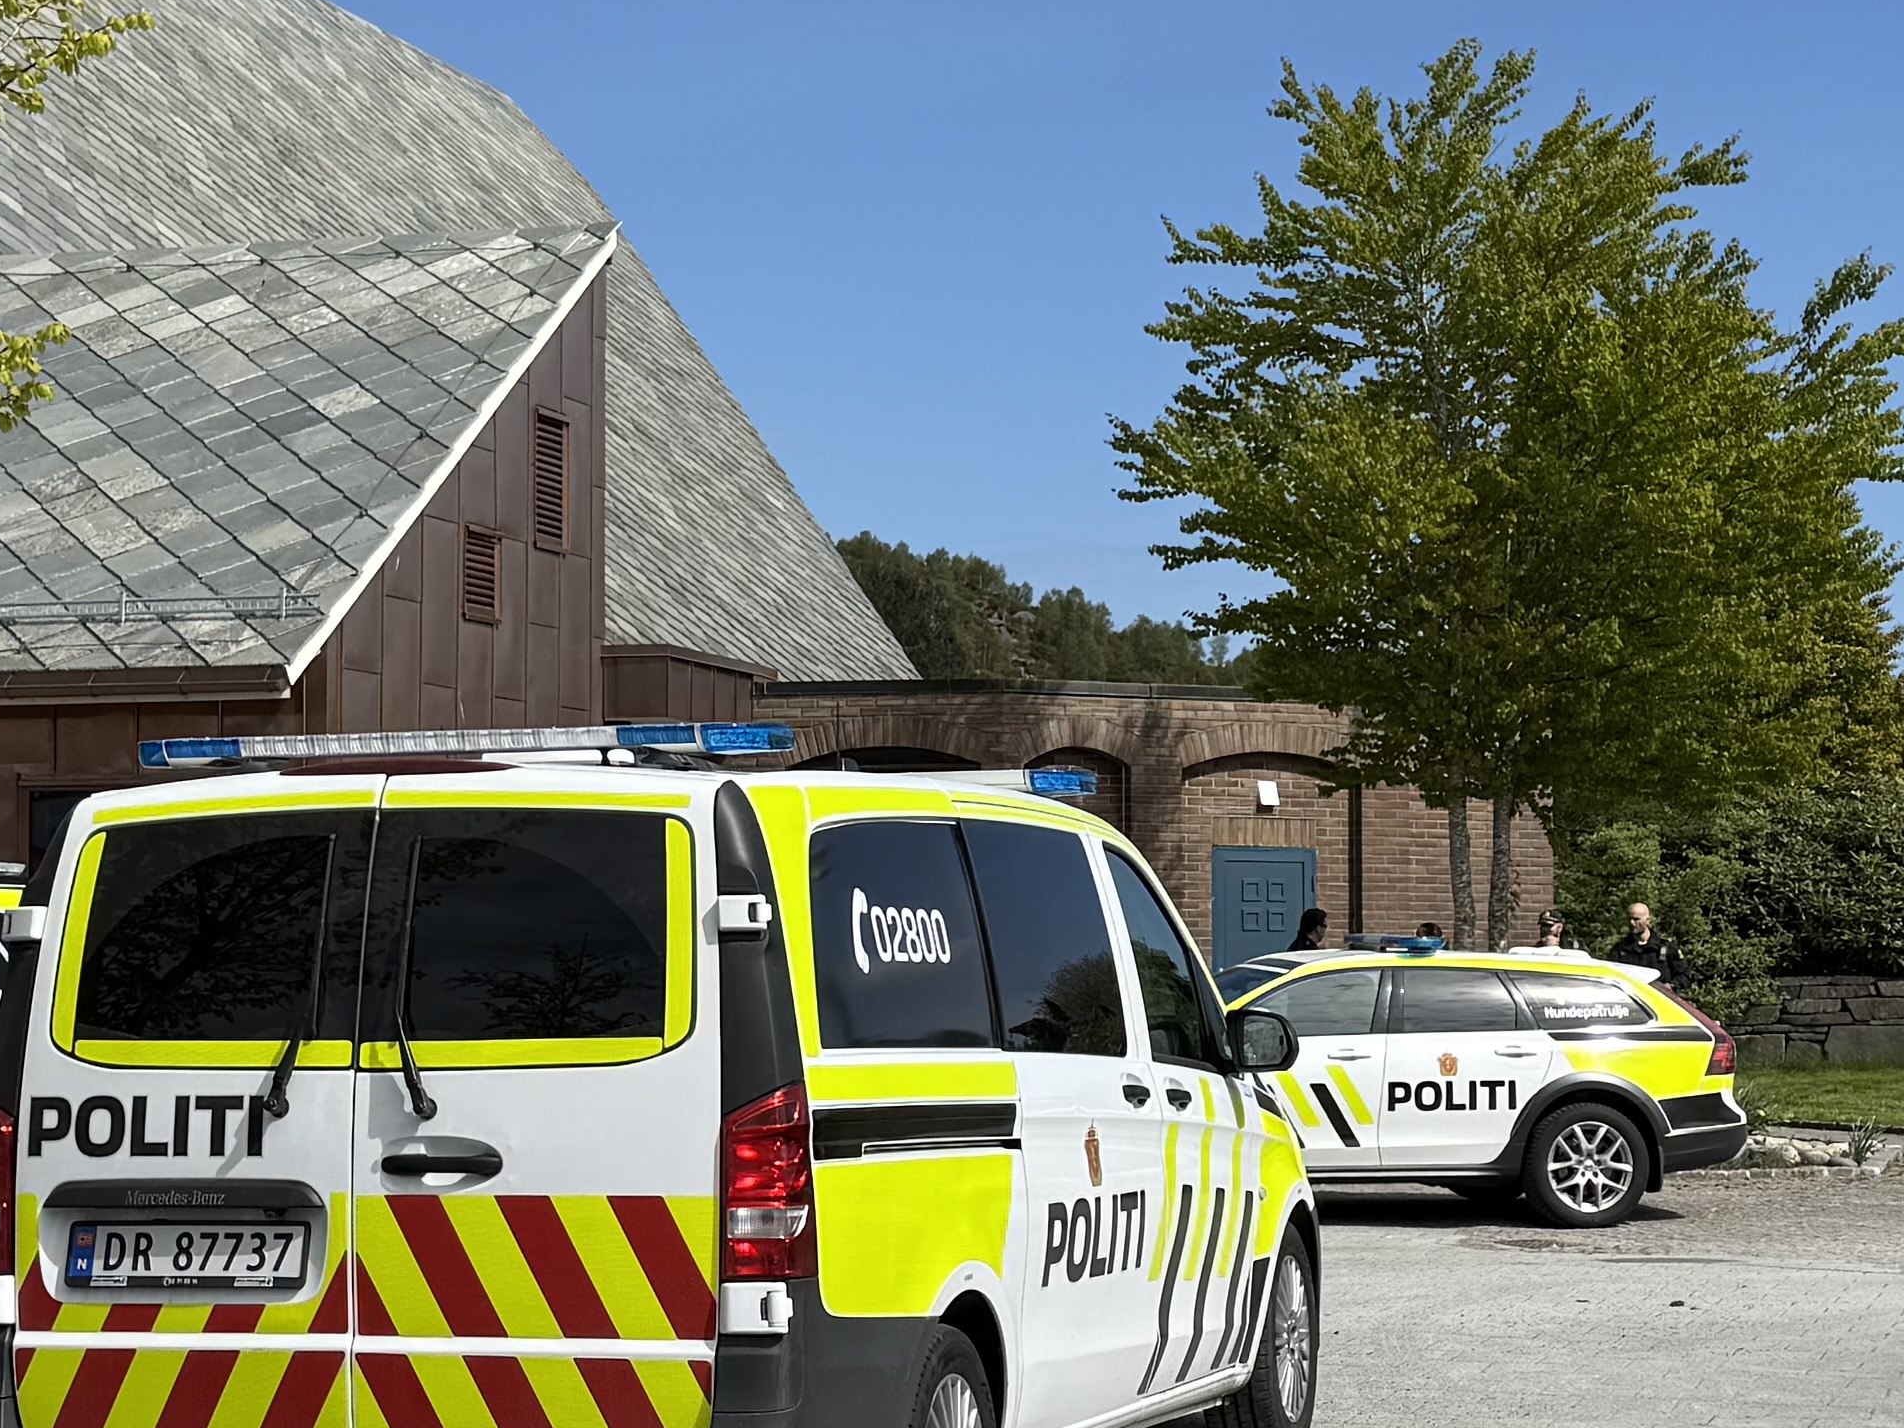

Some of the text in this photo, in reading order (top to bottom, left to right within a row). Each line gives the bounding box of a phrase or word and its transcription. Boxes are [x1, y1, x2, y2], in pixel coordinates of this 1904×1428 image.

[869, 902, 952, 965] 02800
[1387, 1078, 1518, 1113] POLITI
[27, 1094, 266, 1158] POLITI
[124, 1190, 225, 1206] Mercedes-Benz
[102, 1231, 295, 1272] DR 87737
[1041, 1188, 1147, 1289] POLITI
[76, 1258, 88, 1270] N
